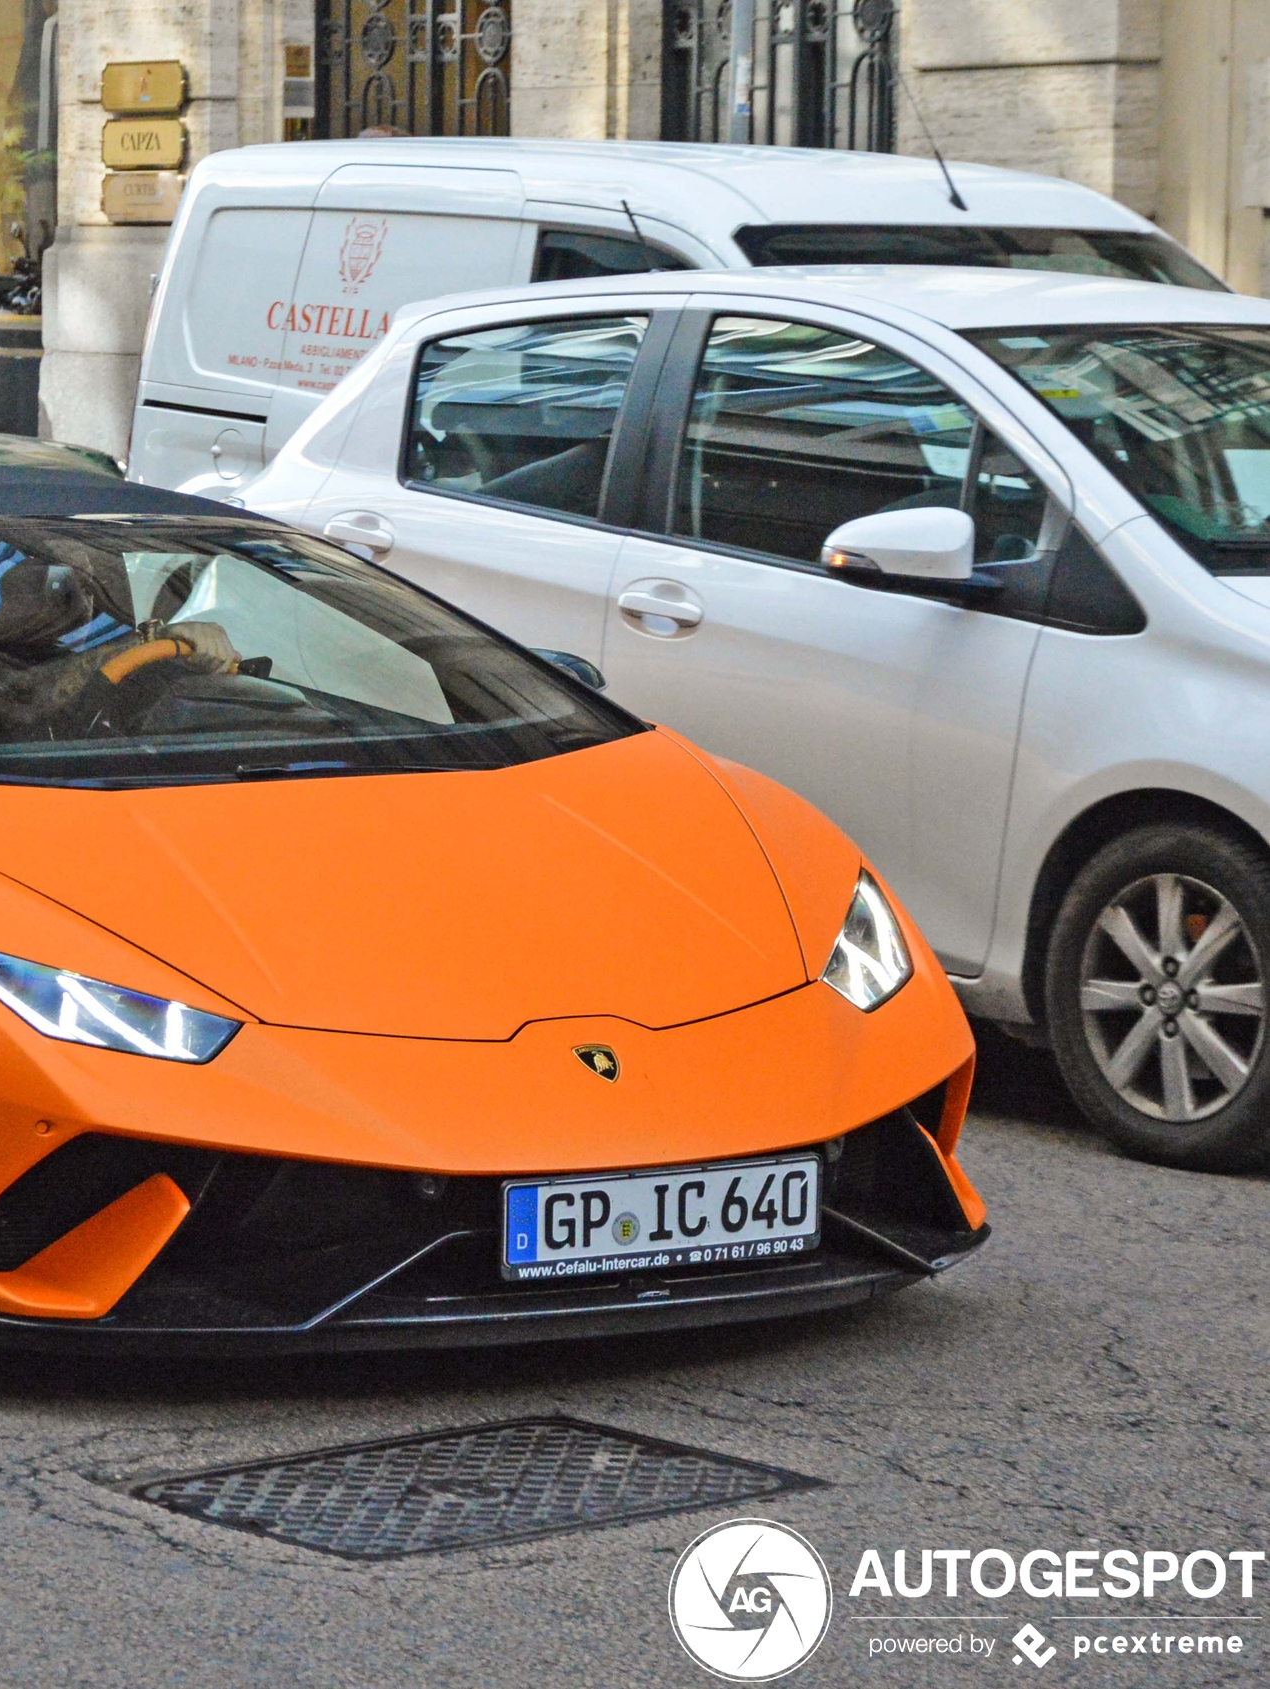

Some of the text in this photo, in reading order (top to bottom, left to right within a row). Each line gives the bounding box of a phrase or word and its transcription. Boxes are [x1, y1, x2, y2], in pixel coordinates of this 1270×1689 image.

[516, 1170, 808, 1250] D GP IC 640
[518, 1253, 670, 1278] www.Cefalu-Intercar.de
[756, 1241, 771, 1256] 96
[773, 1239, 788, 1254] 90
[789, 1237, 804, 1251] 43
